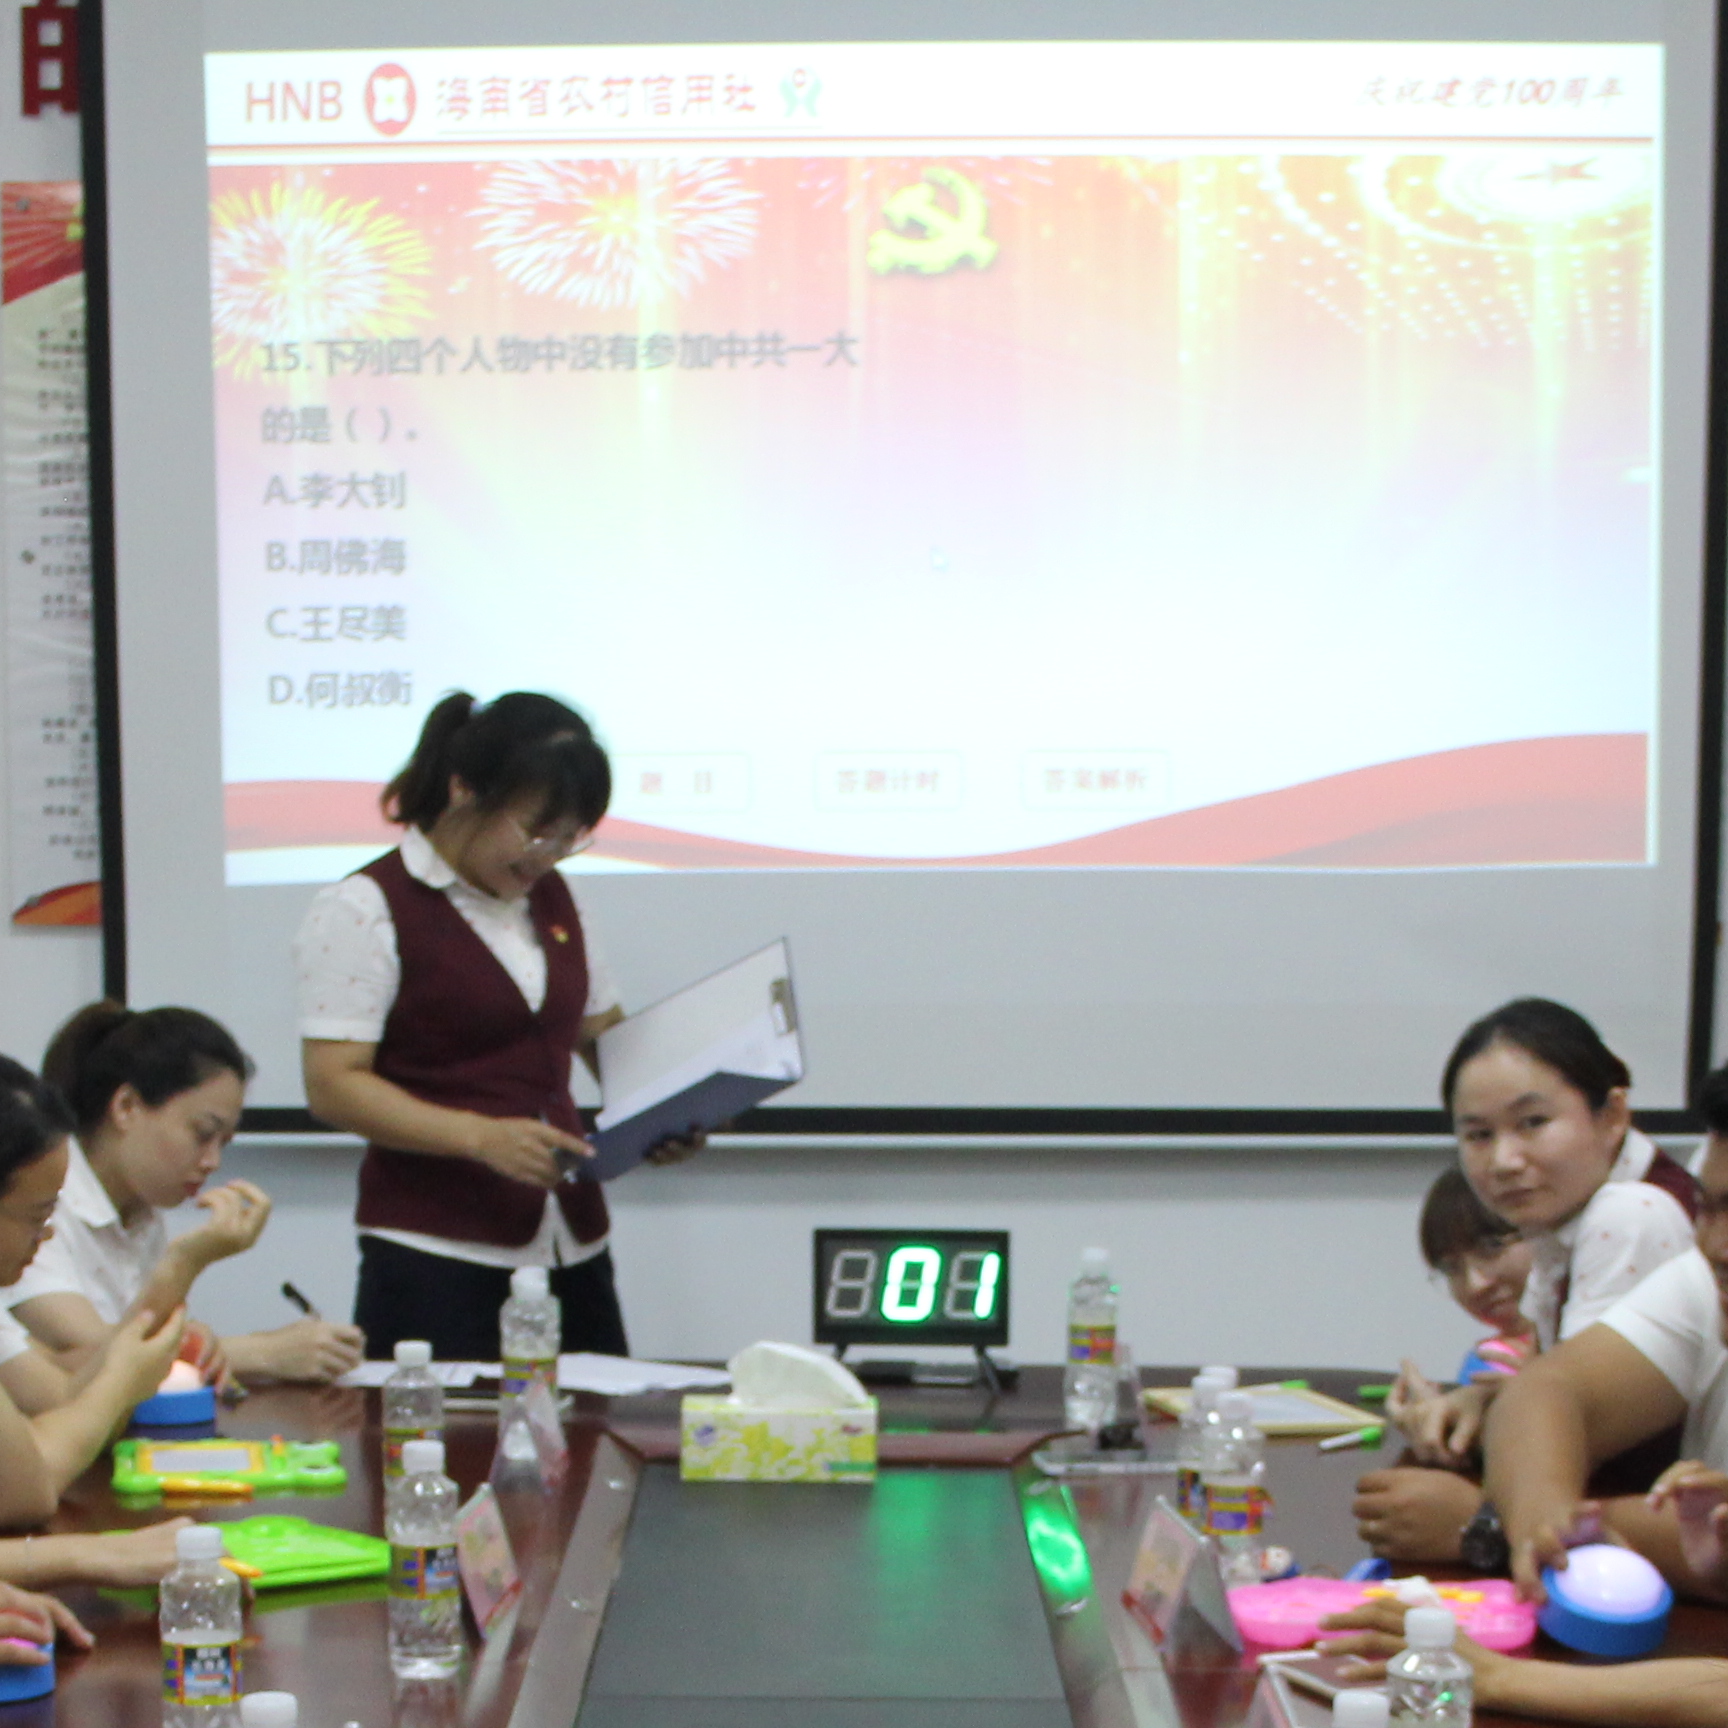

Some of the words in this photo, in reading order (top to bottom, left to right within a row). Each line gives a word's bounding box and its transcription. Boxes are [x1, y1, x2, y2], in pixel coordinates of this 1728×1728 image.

[244, 80, 343, 123] HNB
[435, 73, 759, 121] 海南省农村信用社
[263, 471, 407, 509] A.李大钊
[264, 538, 407, 576] B.周佛海
[265, 604, 407, 642] C.王尽美
[268, 671, 413, 709] D.何叔衡
